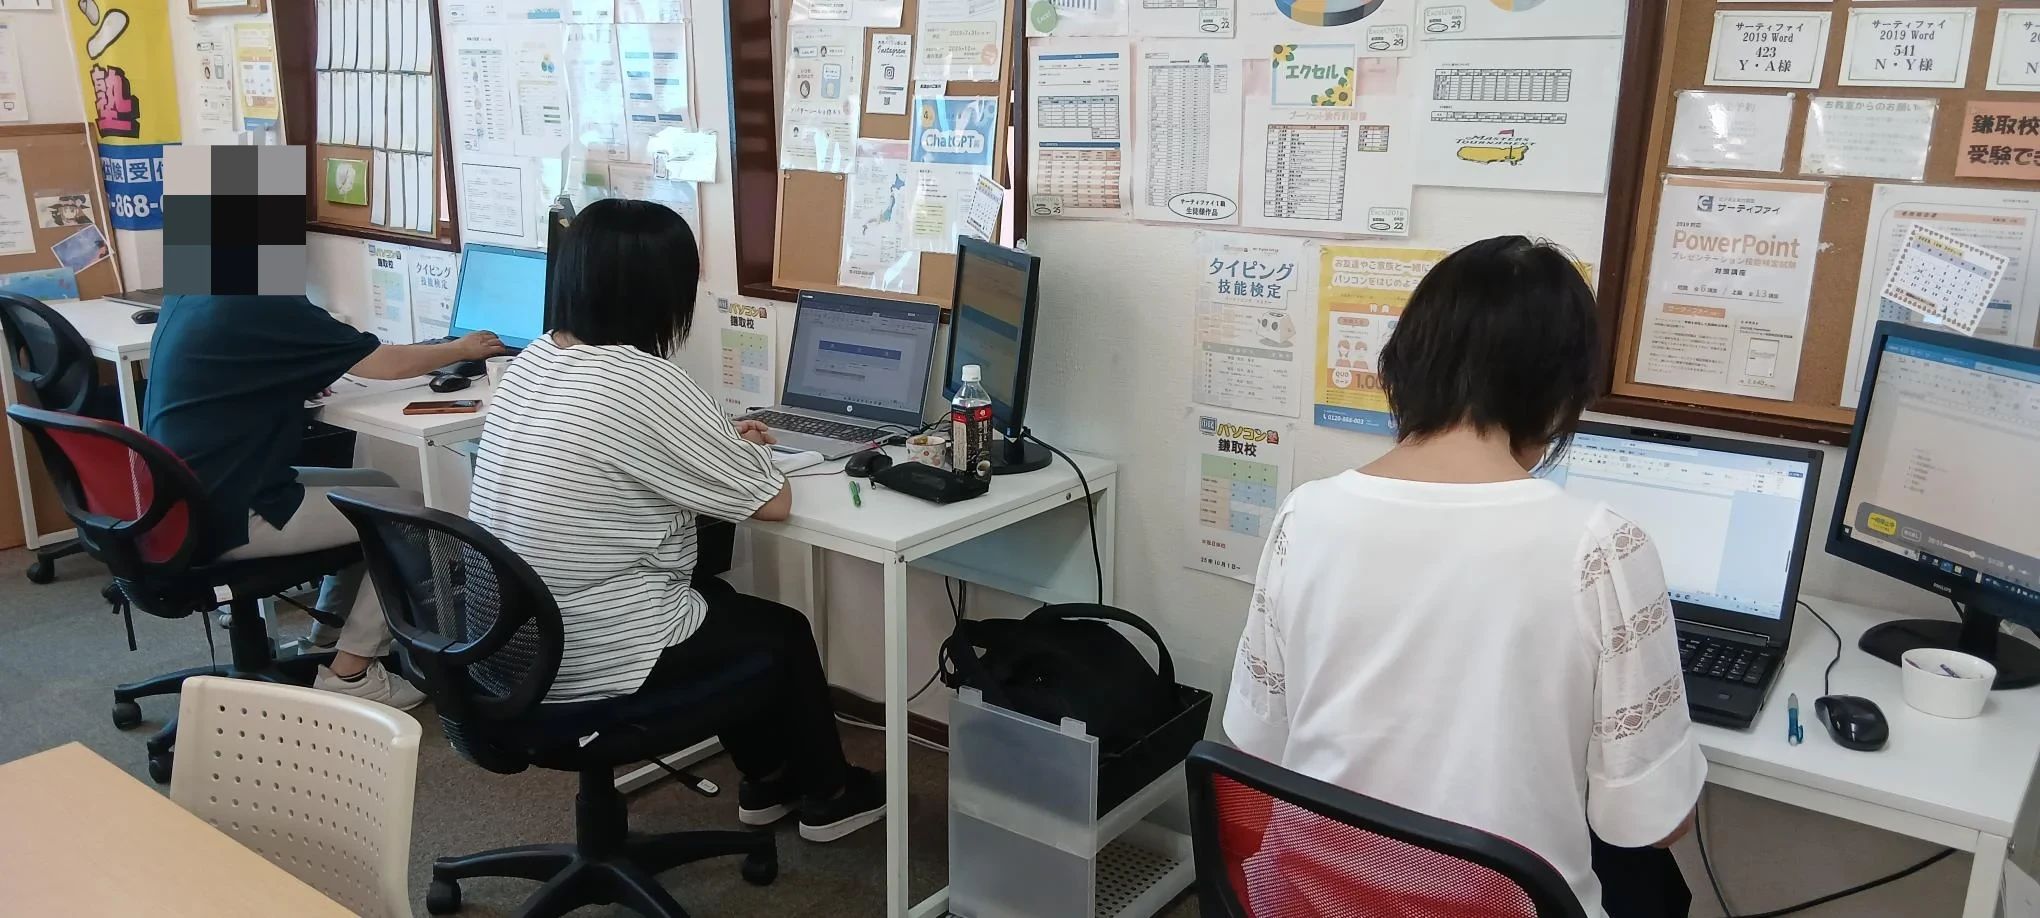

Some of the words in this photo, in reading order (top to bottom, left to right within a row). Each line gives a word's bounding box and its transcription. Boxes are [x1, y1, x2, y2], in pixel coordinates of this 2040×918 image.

[1221, 21, 1230, 29] 22
[1451, 21, 1461, 29] 29
[1735, 22, 1804, 33] サーティファイ
[1872, 19, 1946, 30] サーティファイ
[1743, 32, 1768, 42] 2019
[1772, 32, 1794, 43] Word
[1880, 30, 1906, 41] 2019
[1911, 30, 1935, 41] Word
[1393, 38, 1404, 47] 29
[1755, 46, 1777, 58] 423
[1893, 44, 1916, 57] 541
[1286, 64, 1339, 80] エクセル
[1971, 114, 2040, 136] 鎌取校
[925, 133, 975, 149] ChatGPT
[1717, 203, 1781, 215] サーティファイ
[1393, 222, 1404, 230] 22
[1672, 228, 1800, 259] PowerPoint
[416, 262, 451, 278] タイピング
[1209, 257, 1295, 281] タイピング
[1218, 279, 1281, 299] 技能検定
[1216, 422, 1280, 444] パソコン塾
[1217, 438, 1257, 457] 鎌取校
